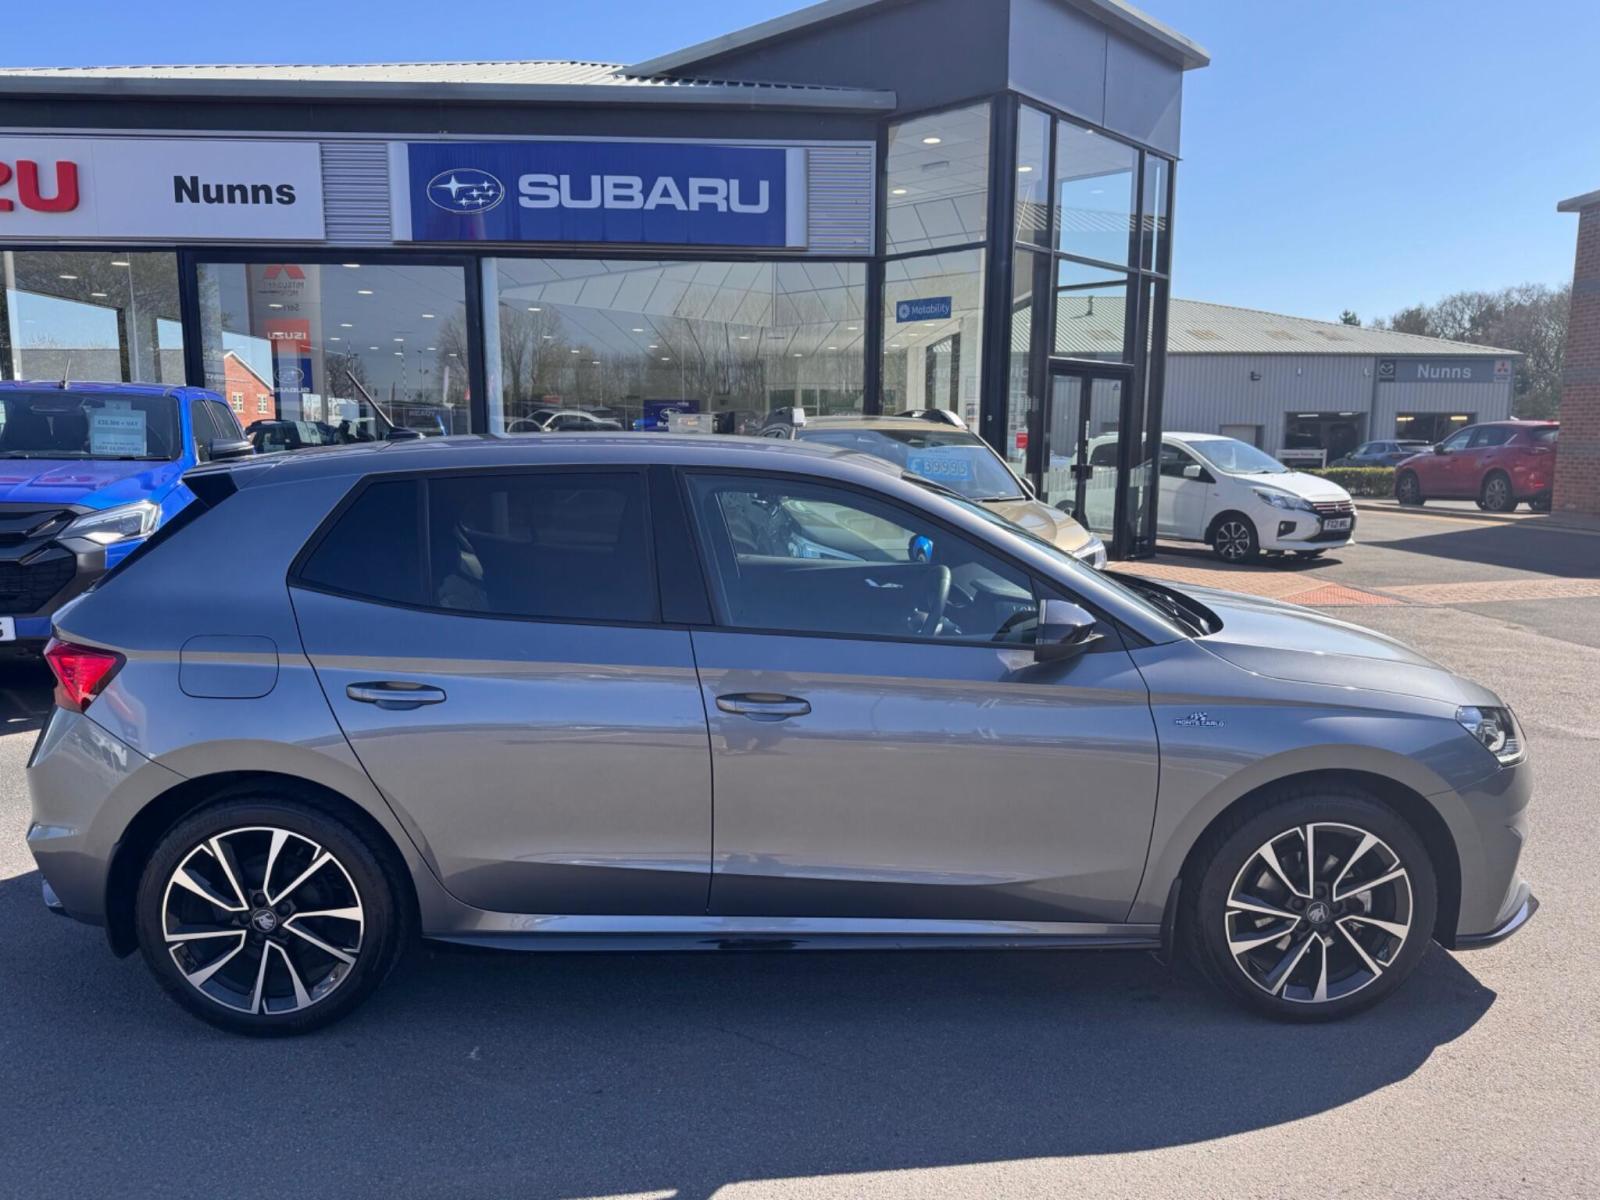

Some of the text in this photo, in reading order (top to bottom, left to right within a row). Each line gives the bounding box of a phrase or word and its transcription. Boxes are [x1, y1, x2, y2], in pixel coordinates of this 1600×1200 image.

[0, 159, 80, 213] U
[173, 175, 297, 206] Nunns
[517, 173, 770, 214] SUBARU
[911, 303, 950, 315] Motability
[1416, 363, 1472, 380] Nunns
